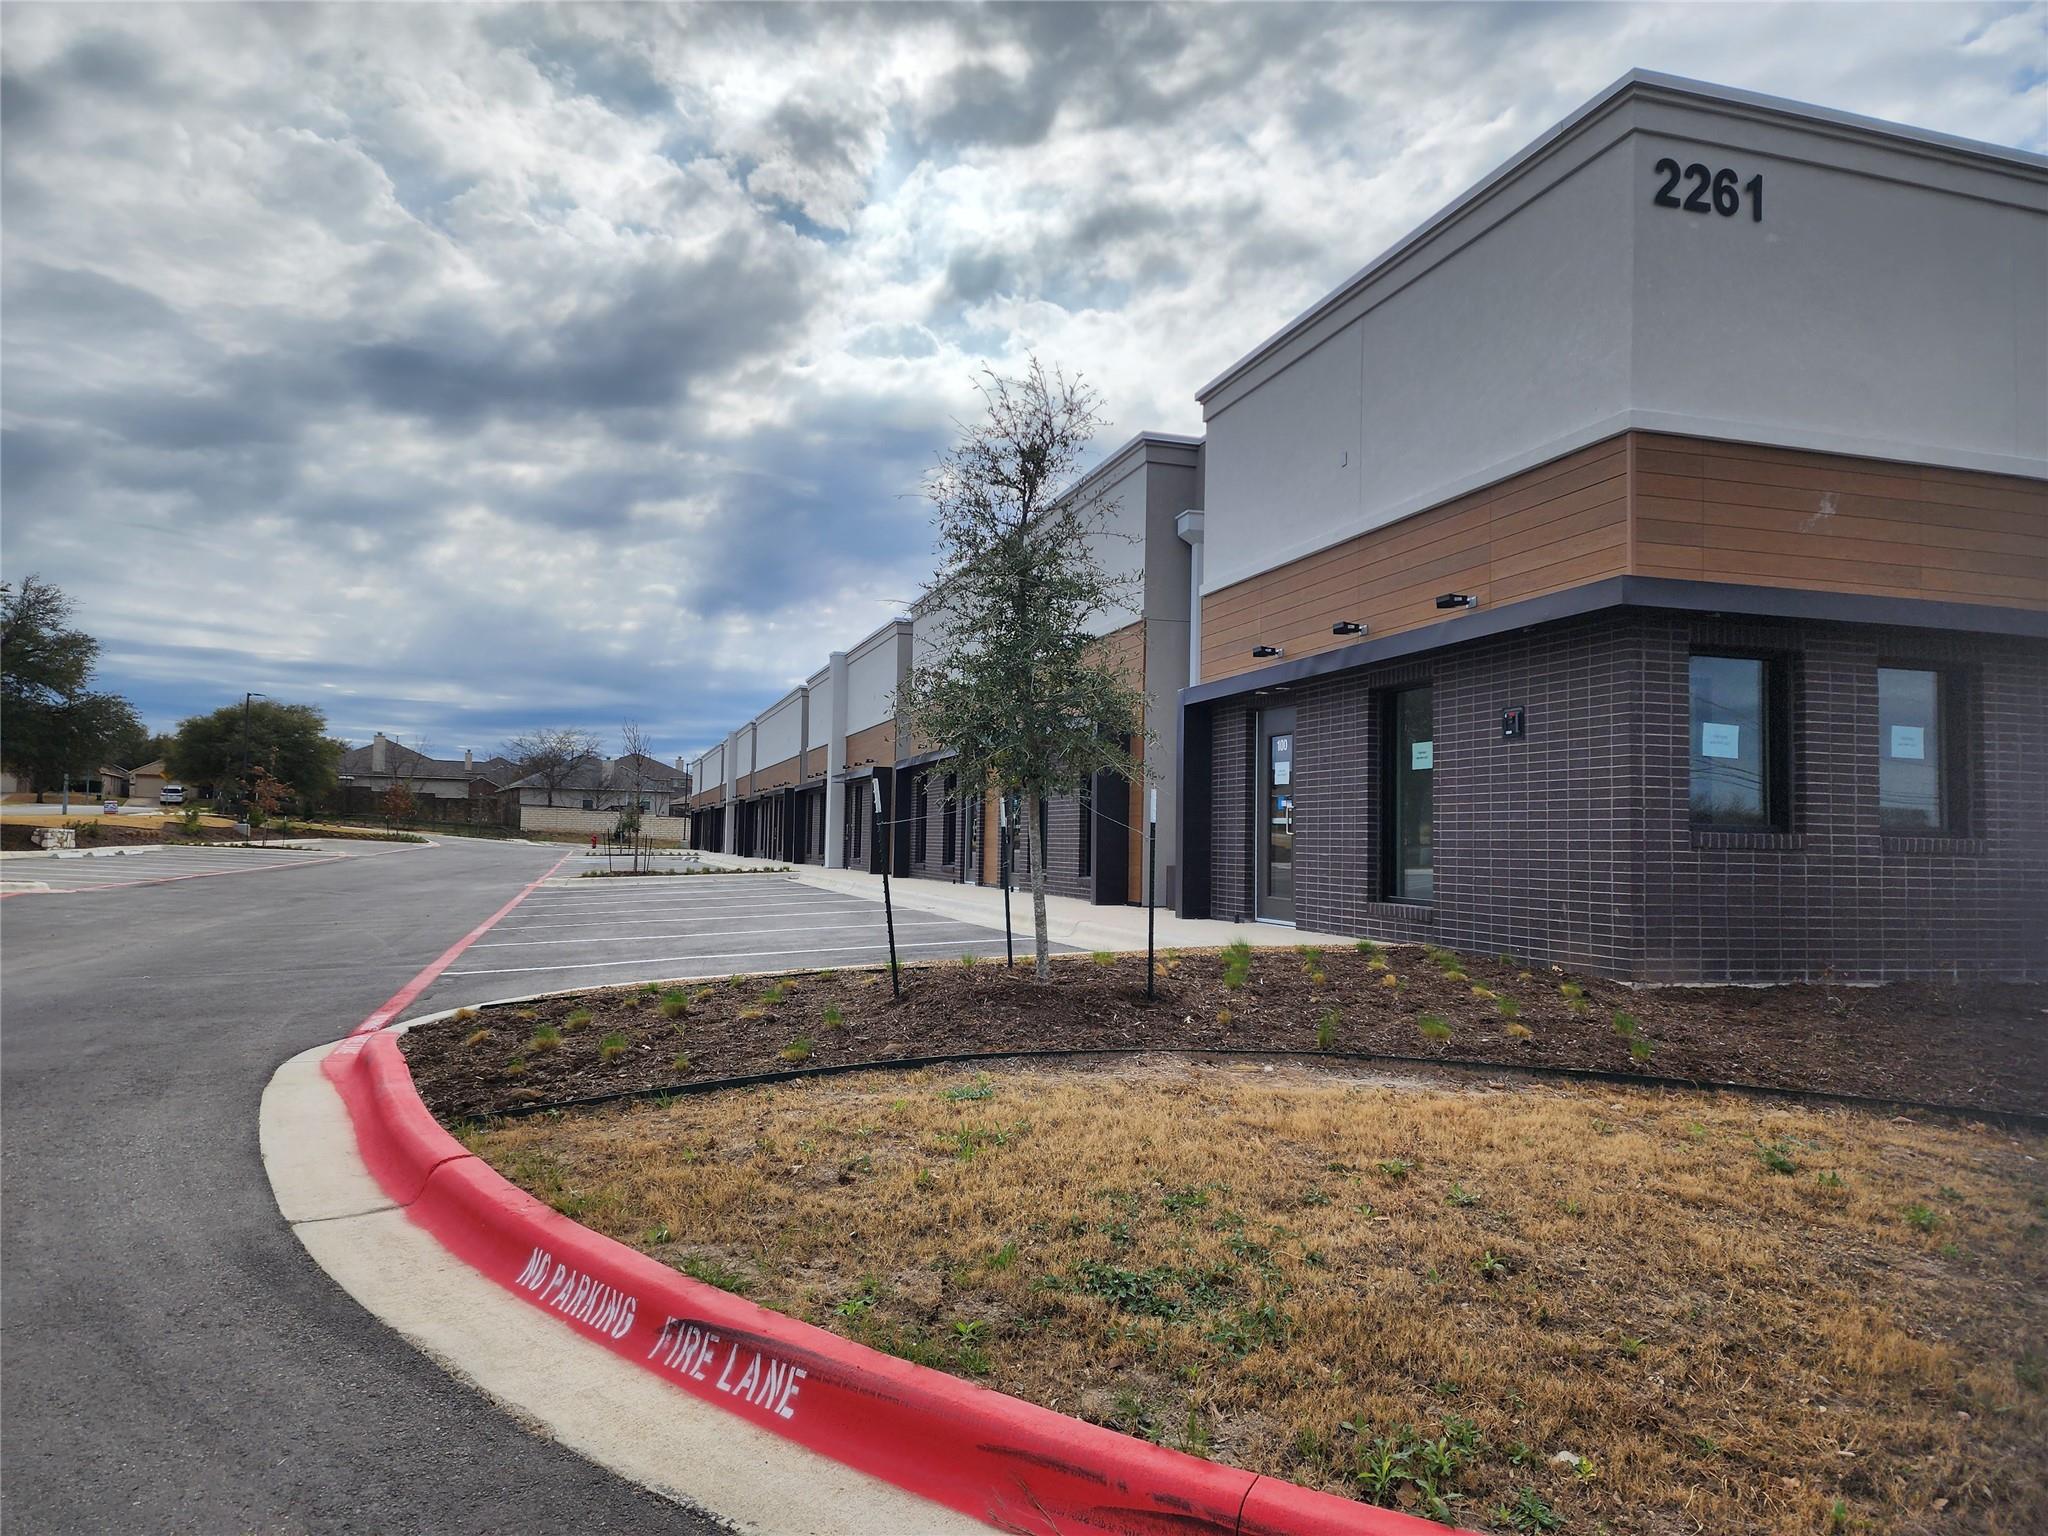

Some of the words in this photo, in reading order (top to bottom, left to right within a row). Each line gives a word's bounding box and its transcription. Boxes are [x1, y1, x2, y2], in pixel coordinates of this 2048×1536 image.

[1654, 158, 1763, 223] 2261
[1276, 738, 1288, 752] 100
[515, 1247, 551, 1291] NO
[539, 1263, 637, 1339] PARKING
[648, 1315, 720, 1381] FIRE
[716, 1343, 807, 1420] LANE
